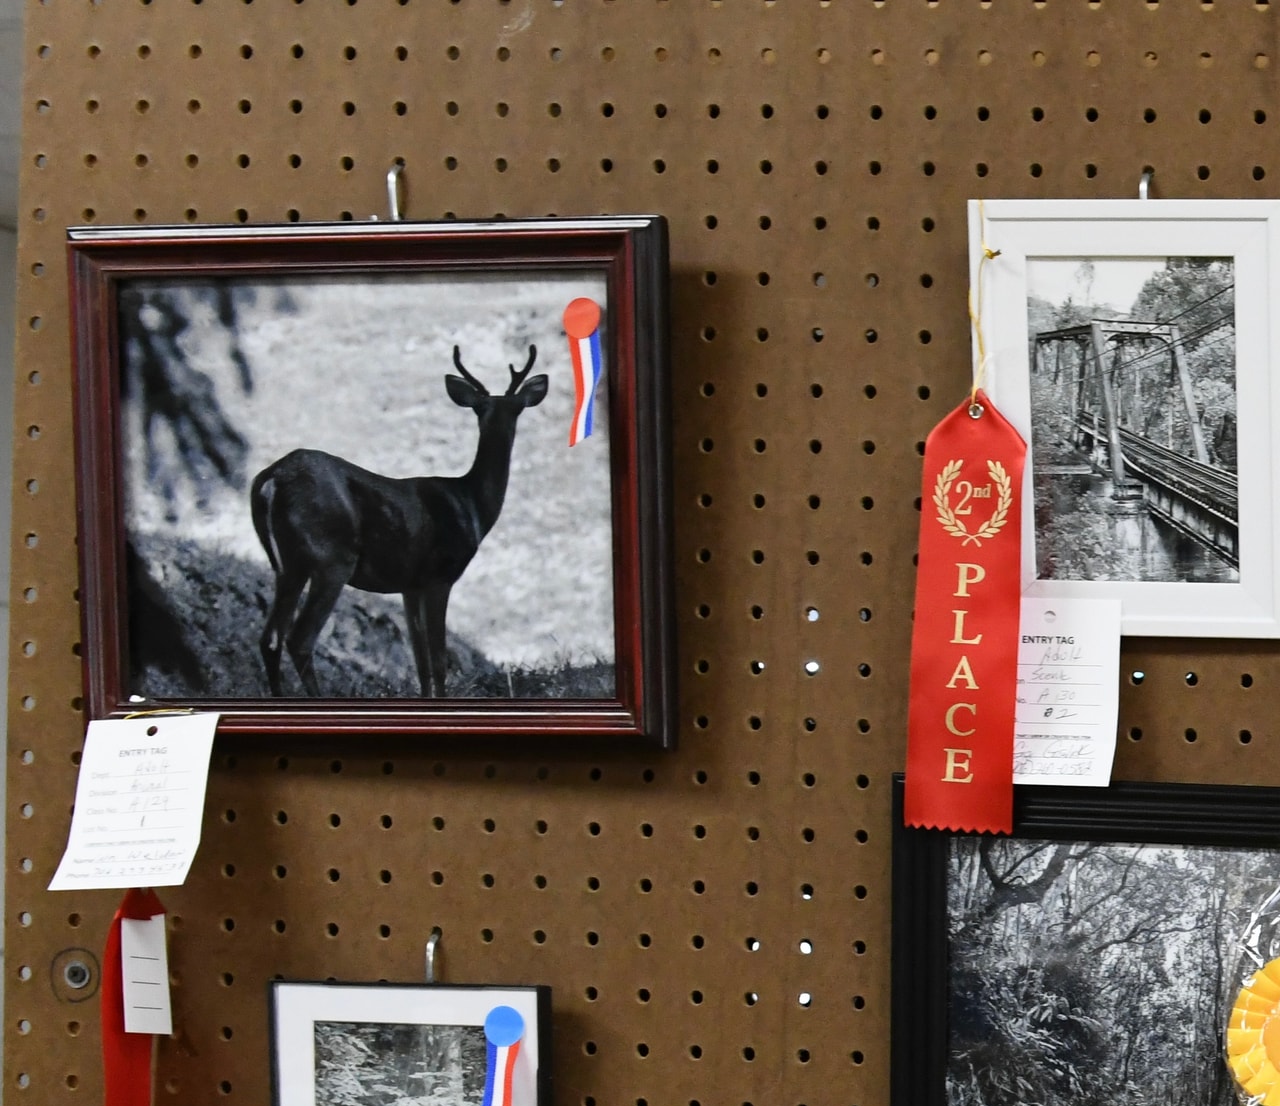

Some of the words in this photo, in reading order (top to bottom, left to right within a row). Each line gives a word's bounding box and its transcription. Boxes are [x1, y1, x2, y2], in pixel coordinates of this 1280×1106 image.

[955, 480, 992, 516] 2nd
[1022, 636, 1054, 645] ENTRY
[1056, 636, 1075, 645] TAG
[940, 562, 987, 784] PLACE
[119, 749, 147, 758] ENTRY
[150, 747, 168, 755] TAG
